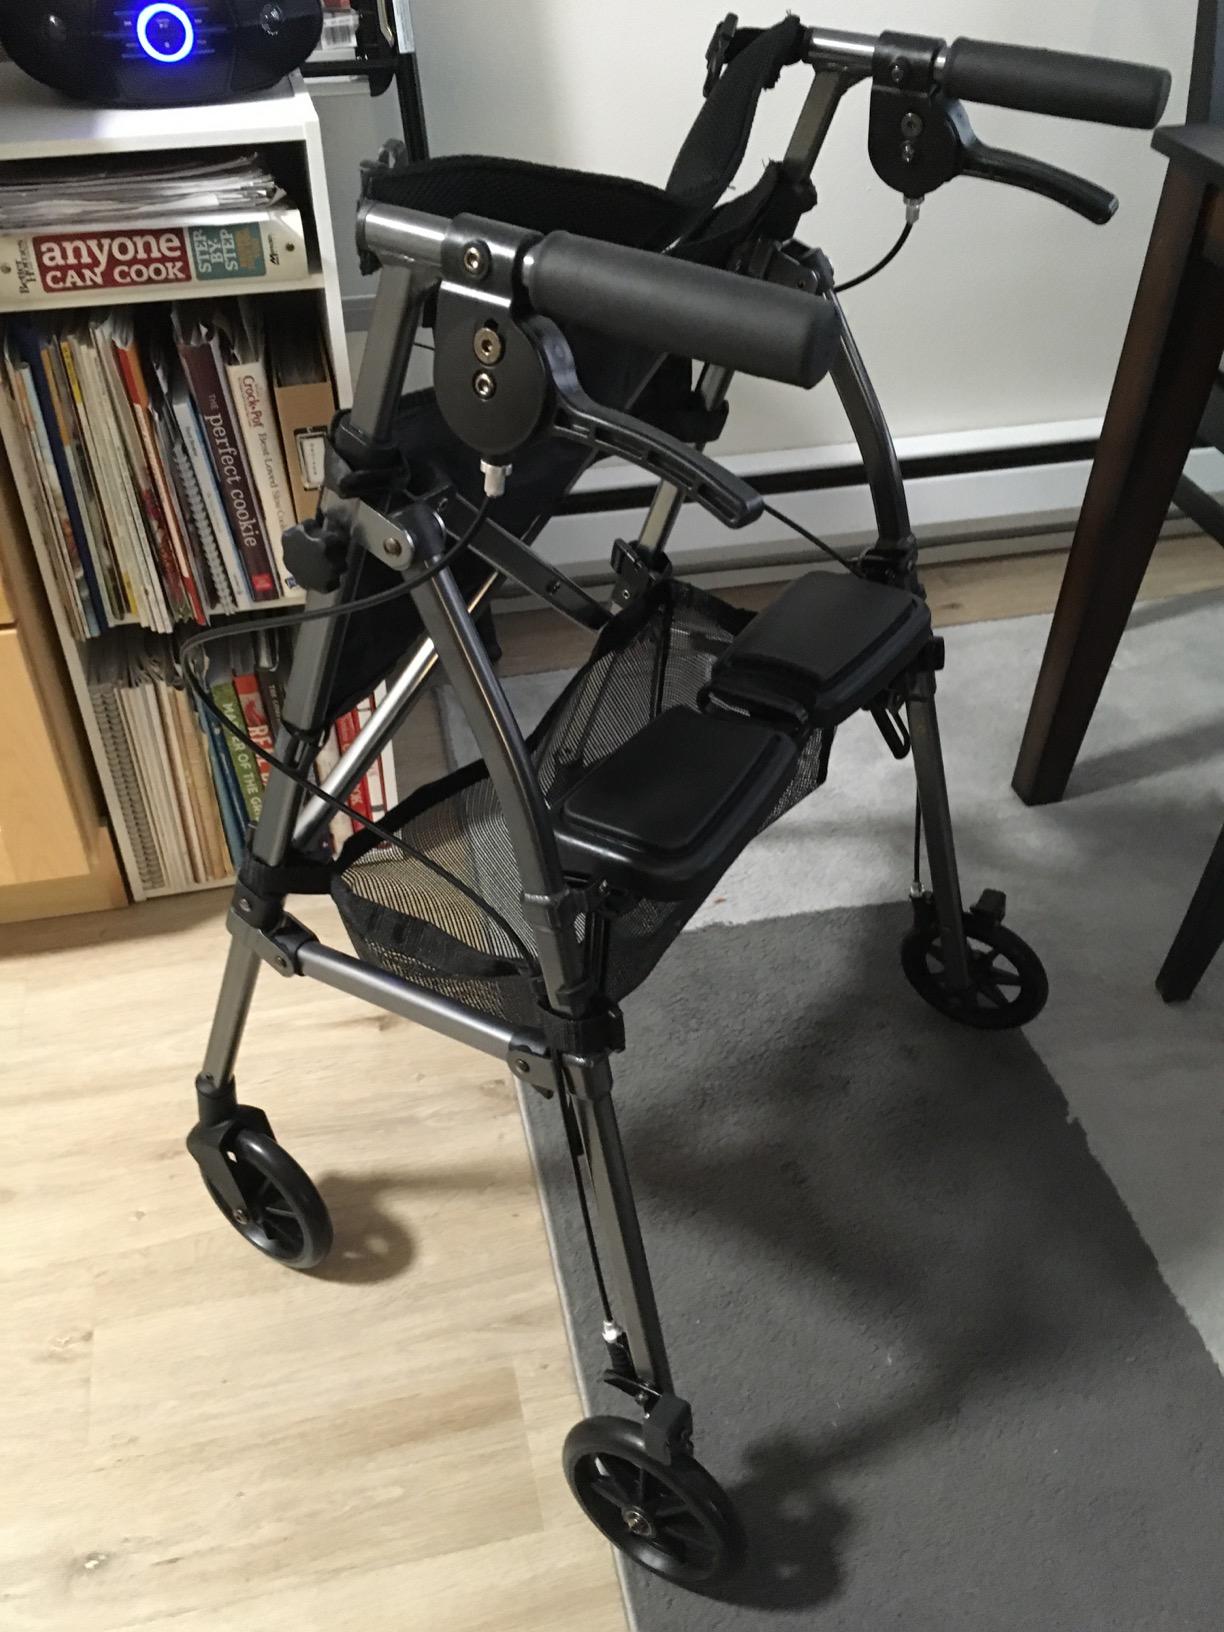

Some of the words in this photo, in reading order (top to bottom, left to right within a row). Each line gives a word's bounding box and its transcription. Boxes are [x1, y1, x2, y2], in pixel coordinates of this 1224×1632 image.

[40, 233, 182, 272] anyone
[193, 228, 212, 272] STEP
[208, 238, 224, 264] BY
[220, 228, 239, 271] STEP
[46, 267, 104, 288] CAN
[113, 260, 186, 284] COOK
[204, 413, 242, 485] perfect
[231, 489, 260, 547] cookie
[222, 703, 246, 751] MAER
[237, 753, 251, 770] OF
[243, 773, 258, 794] THE
